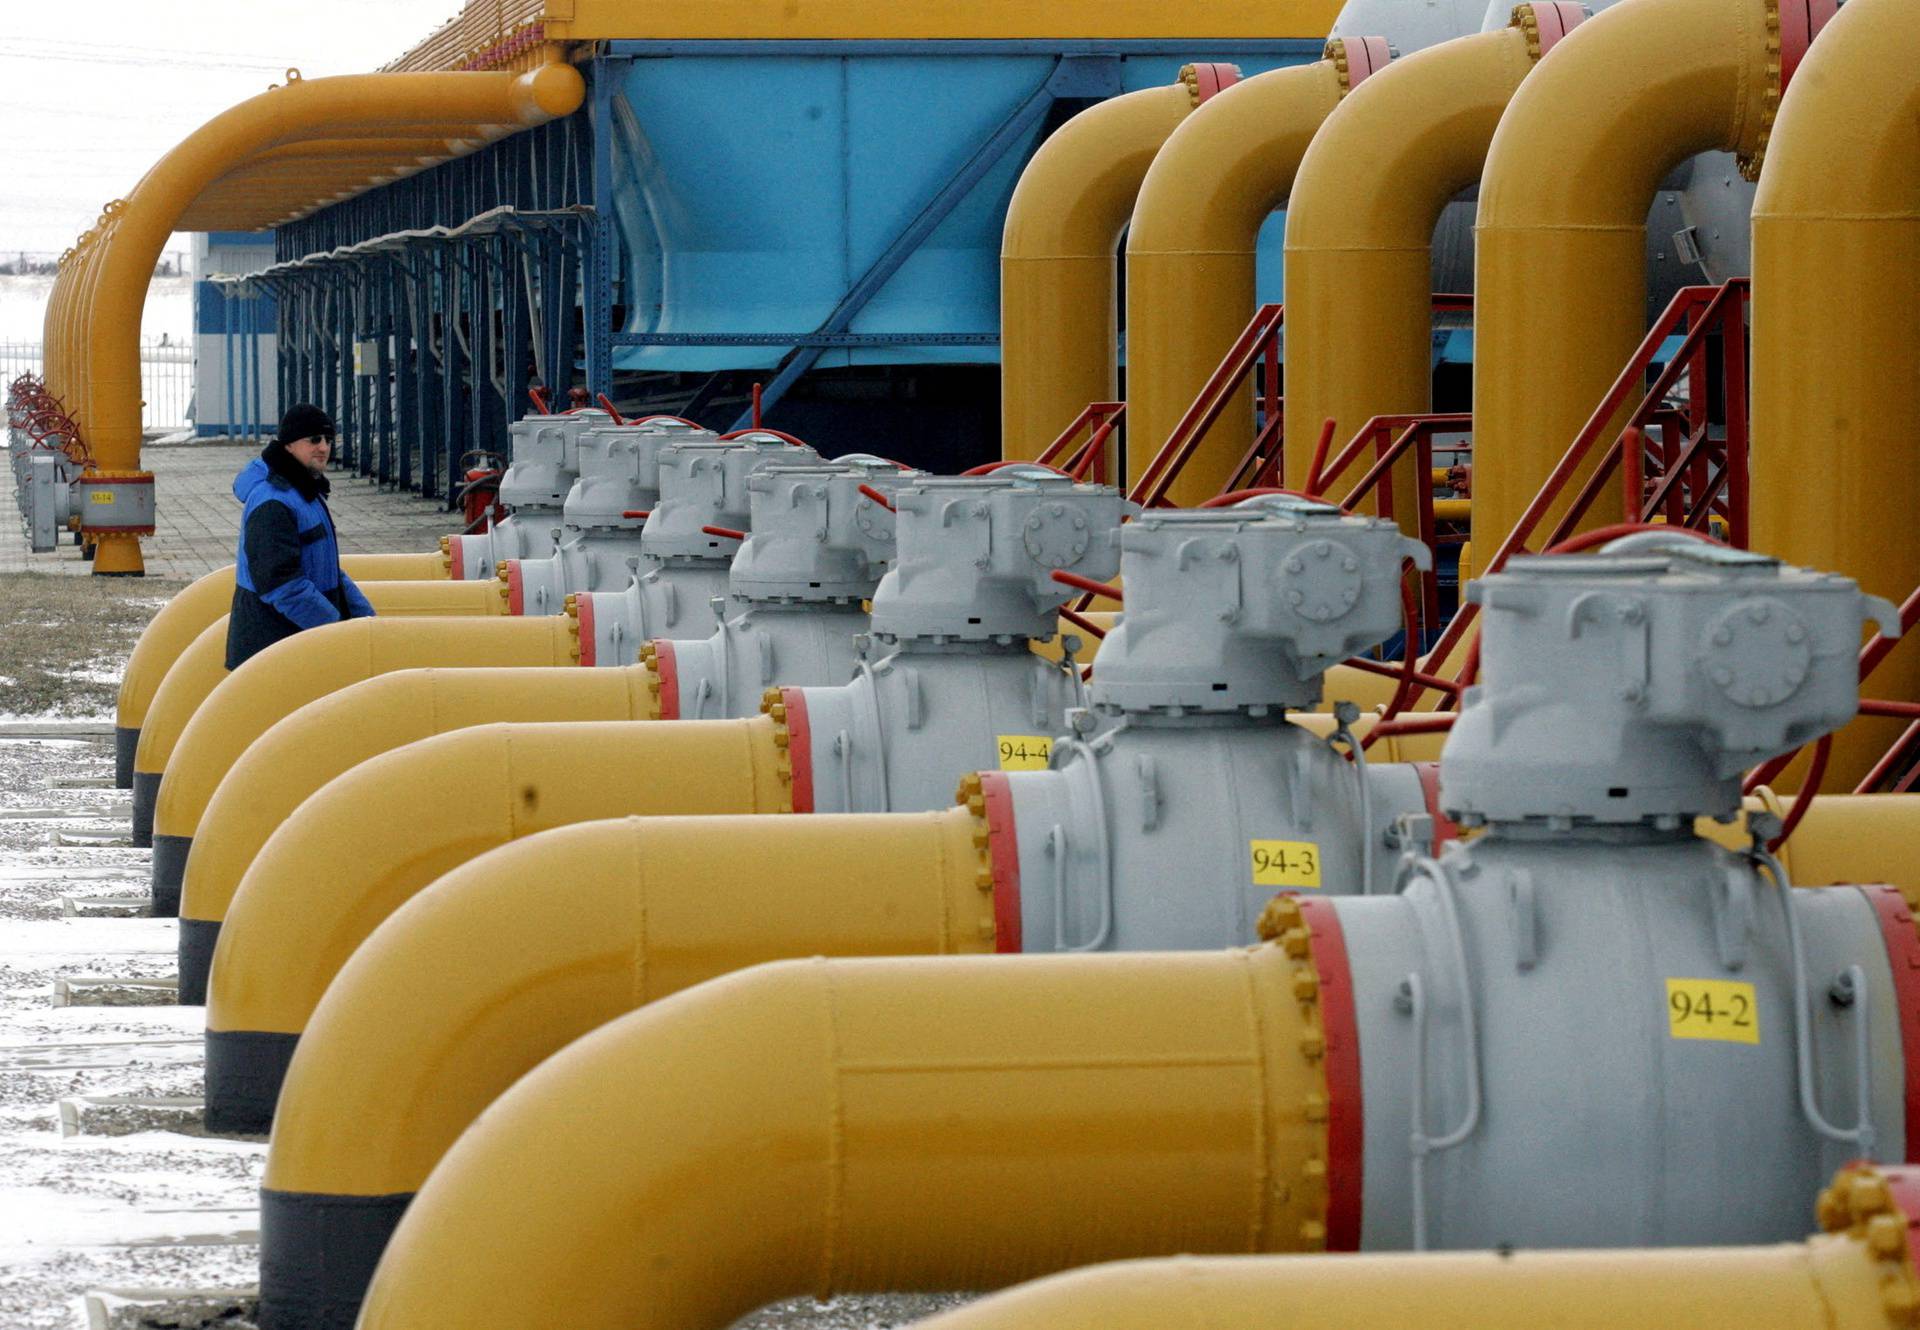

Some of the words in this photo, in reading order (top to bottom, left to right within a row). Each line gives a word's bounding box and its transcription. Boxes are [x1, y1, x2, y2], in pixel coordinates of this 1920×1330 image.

[1000, 741, 1049, 762] 94-4
[1253, 848, 1315, 875] 94-3
[1670, 990, 1751, 1027] 94-2
